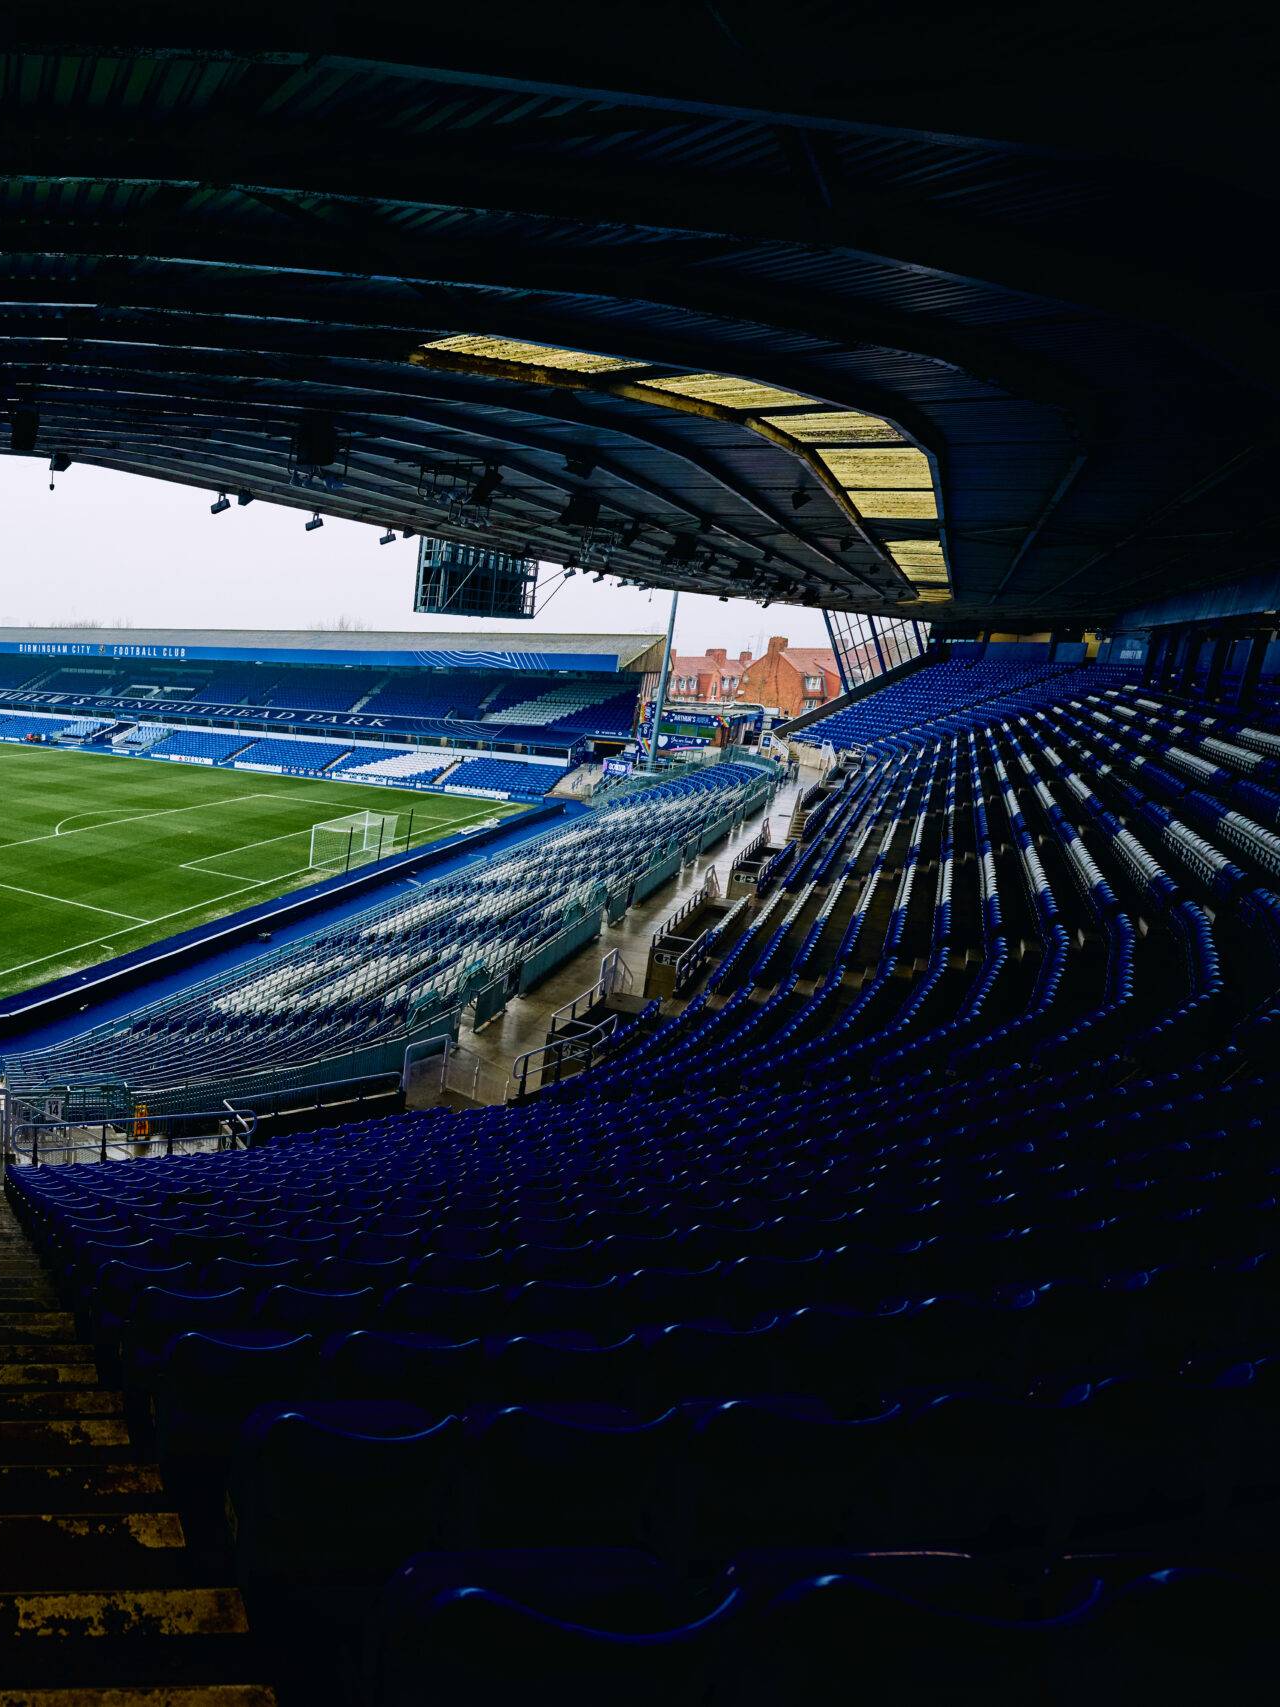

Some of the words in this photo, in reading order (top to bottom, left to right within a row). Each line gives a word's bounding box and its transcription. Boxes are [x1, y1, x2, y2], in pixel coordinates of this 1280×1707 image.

[19, 644, 68, 653] BIRMINGHAM
[71, 645, 91, 654] CITY
[113, 646, 157, 656] FOOTBALL
[162, 647, 186, 657] CLUB
[304, 713, 392, 727] PARK
